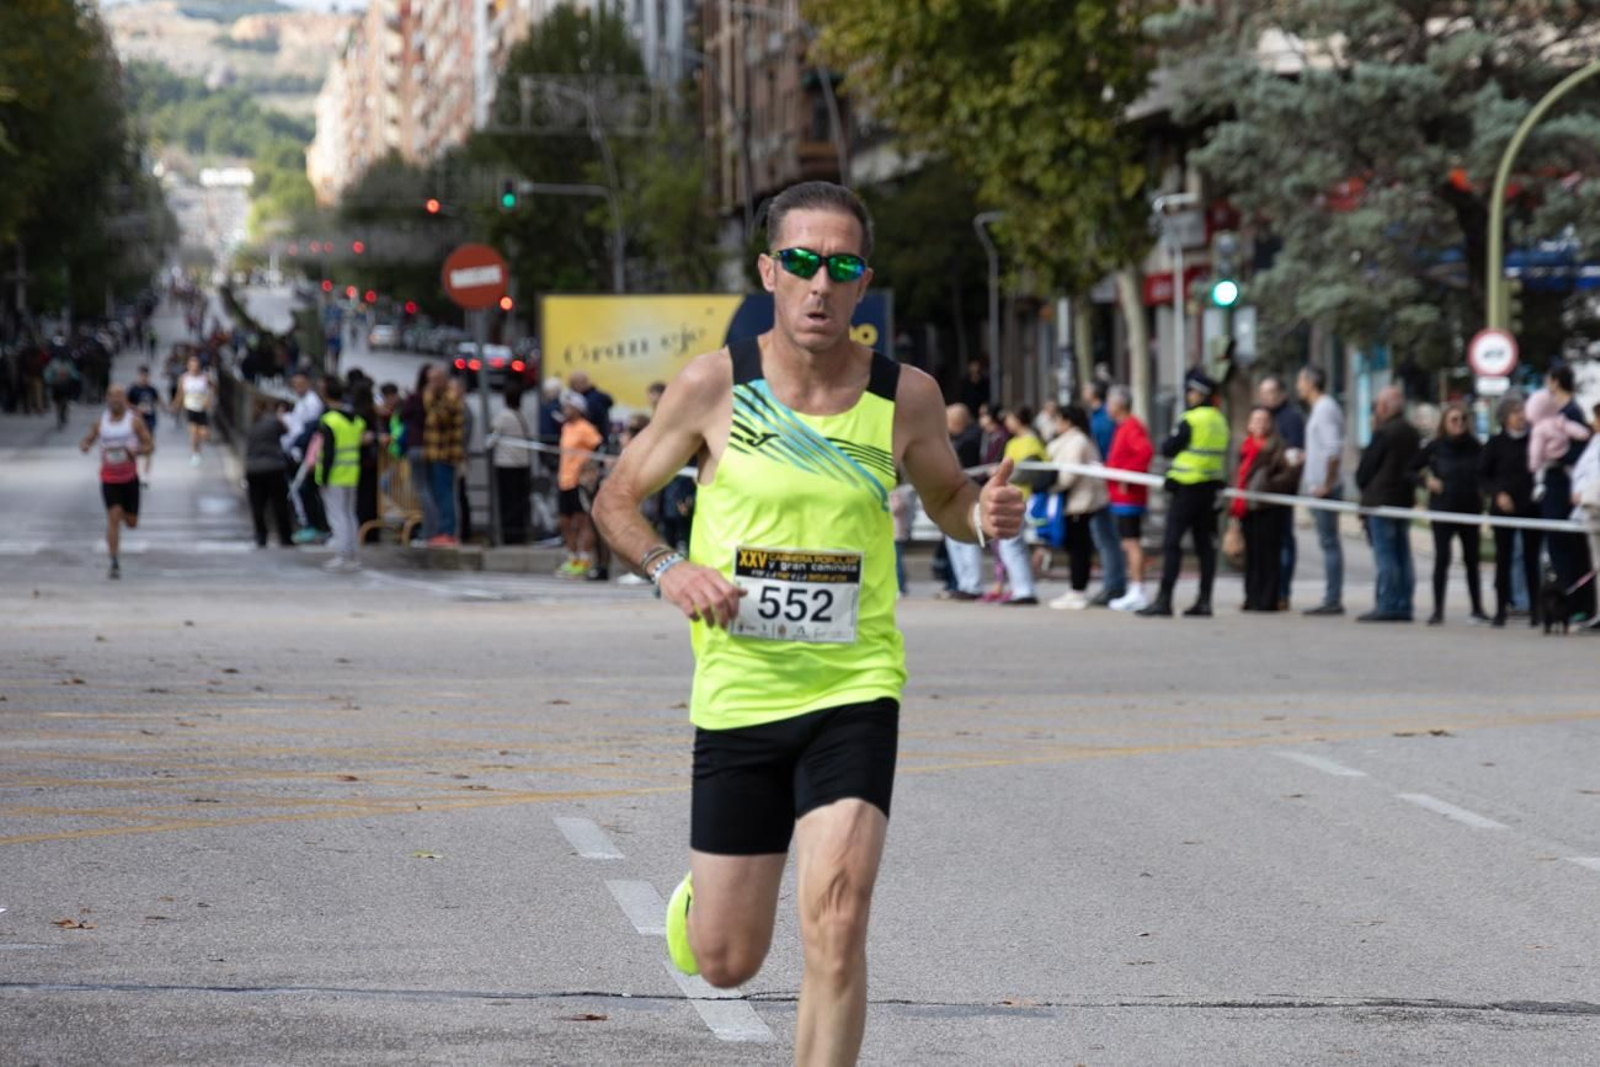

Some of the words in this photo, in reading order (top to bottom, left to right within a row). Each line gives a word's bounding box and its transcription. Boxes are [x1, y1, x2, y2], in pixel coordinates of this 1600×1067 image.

[739, 550, 768, 568] XXV
[780, 561, 806, 571] gran
[811, 563, 858, 573] caminata
[757, 586, 834, 623] 552
